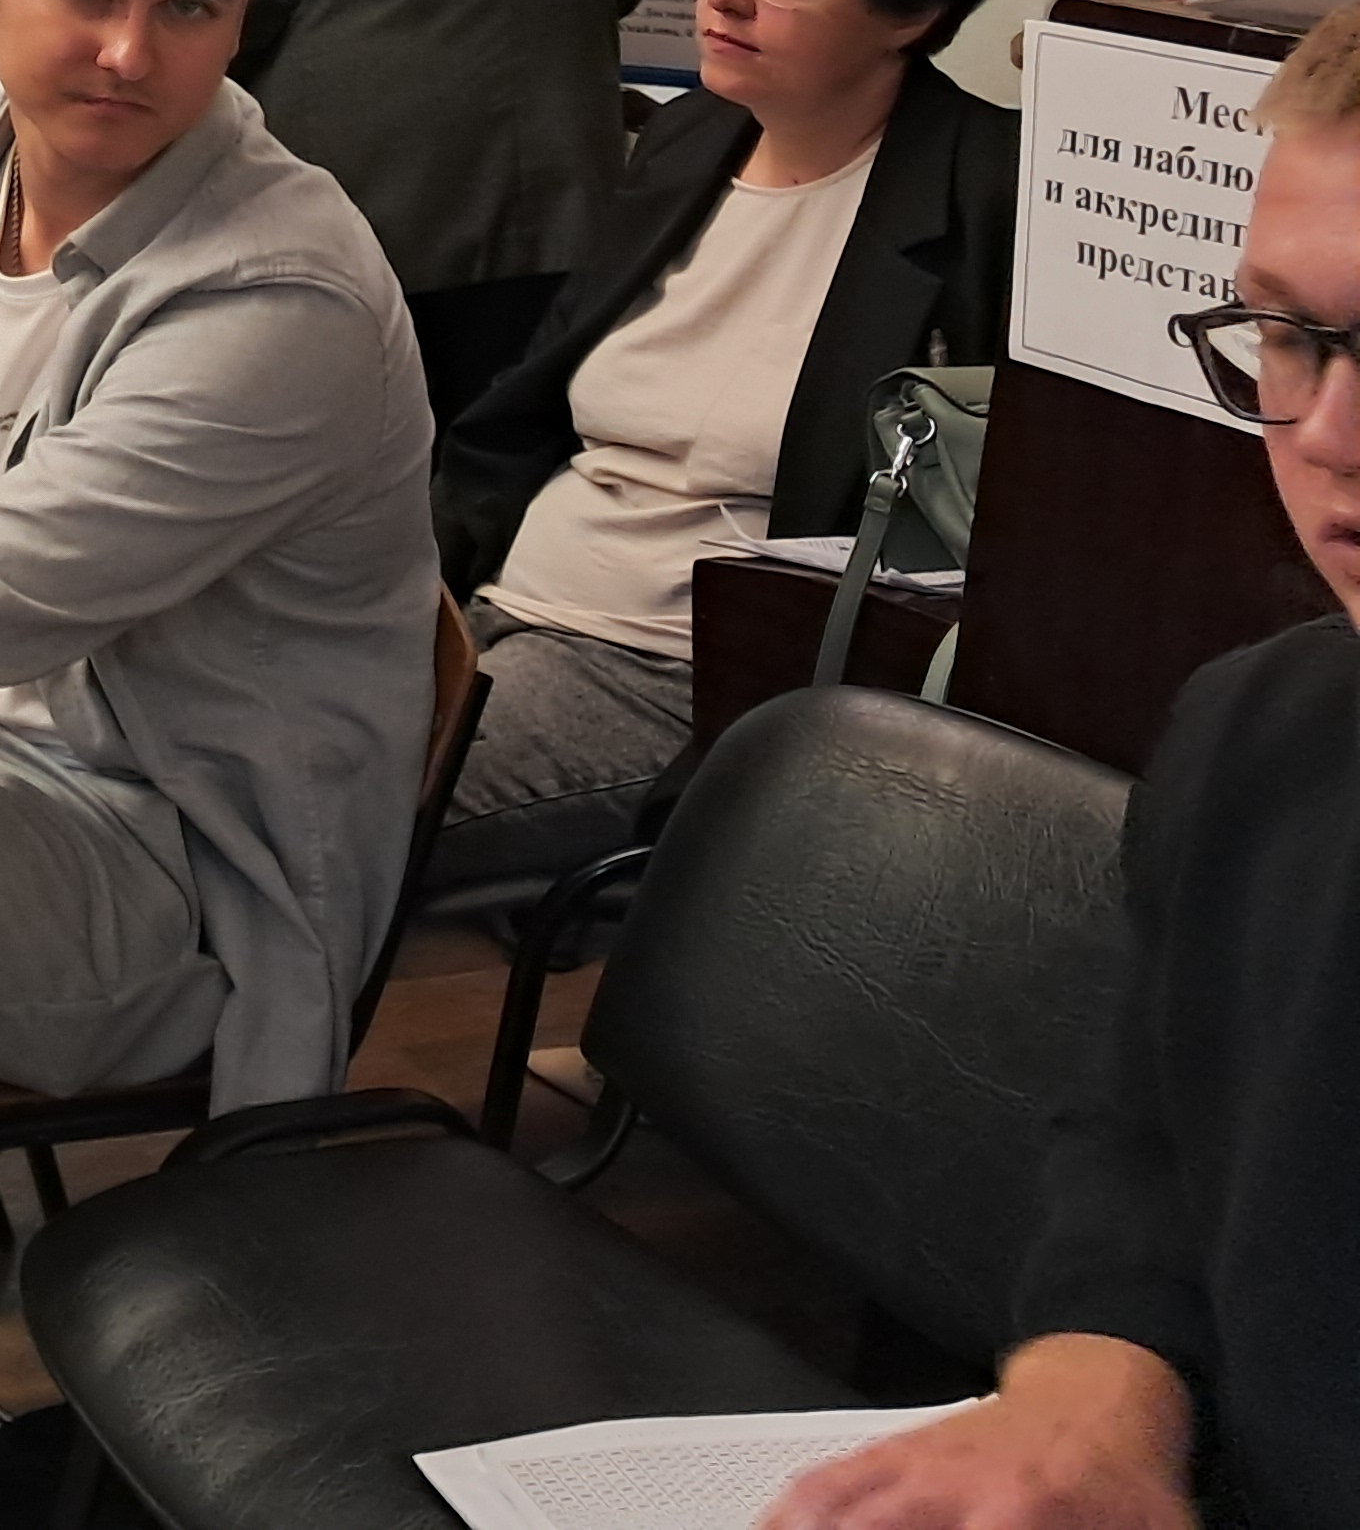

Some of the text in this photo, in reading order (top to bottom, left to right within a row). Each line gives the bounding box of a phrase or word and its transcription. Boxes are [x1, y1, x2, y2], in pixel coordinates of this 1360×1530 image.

[1057, 127, 1254, 193] для наблю
[1044, 177, 1248, 249] и аккредит
